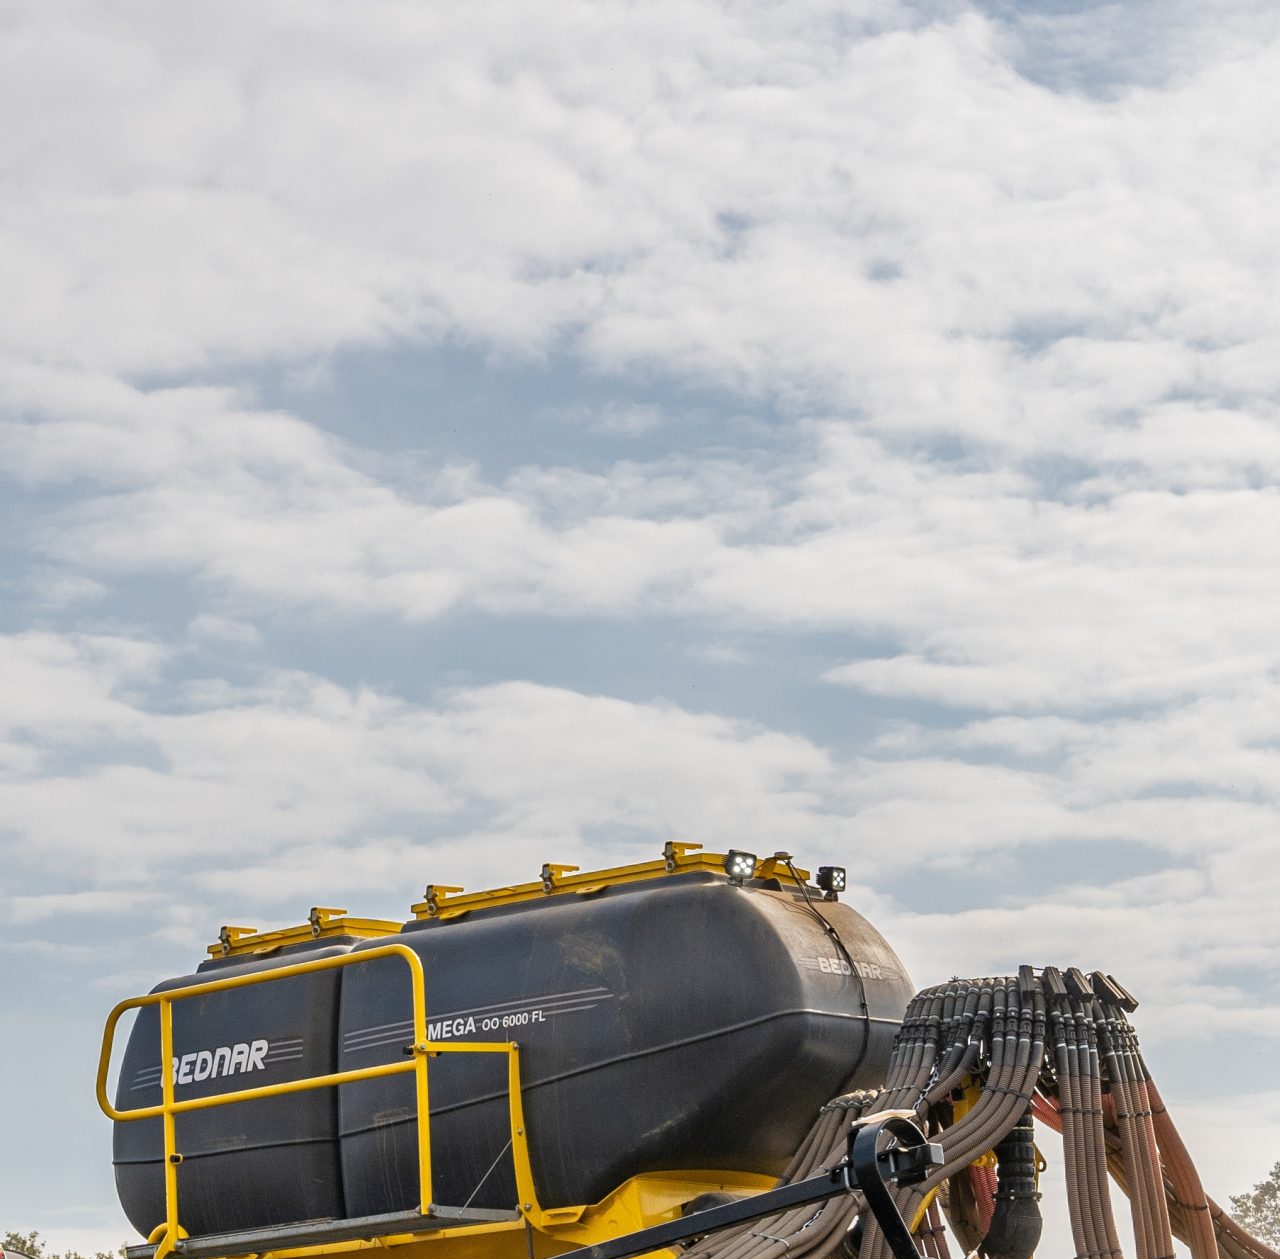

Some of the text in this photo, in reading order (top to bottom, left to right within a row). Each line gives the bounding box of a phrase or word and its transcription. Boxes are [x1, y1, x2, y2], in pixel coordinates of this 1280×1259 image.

[425, 1016, 477, 1041] MEGA
[502, 1012, 529, 1028] 6000
[531, 1010, 547, 1023] FL
